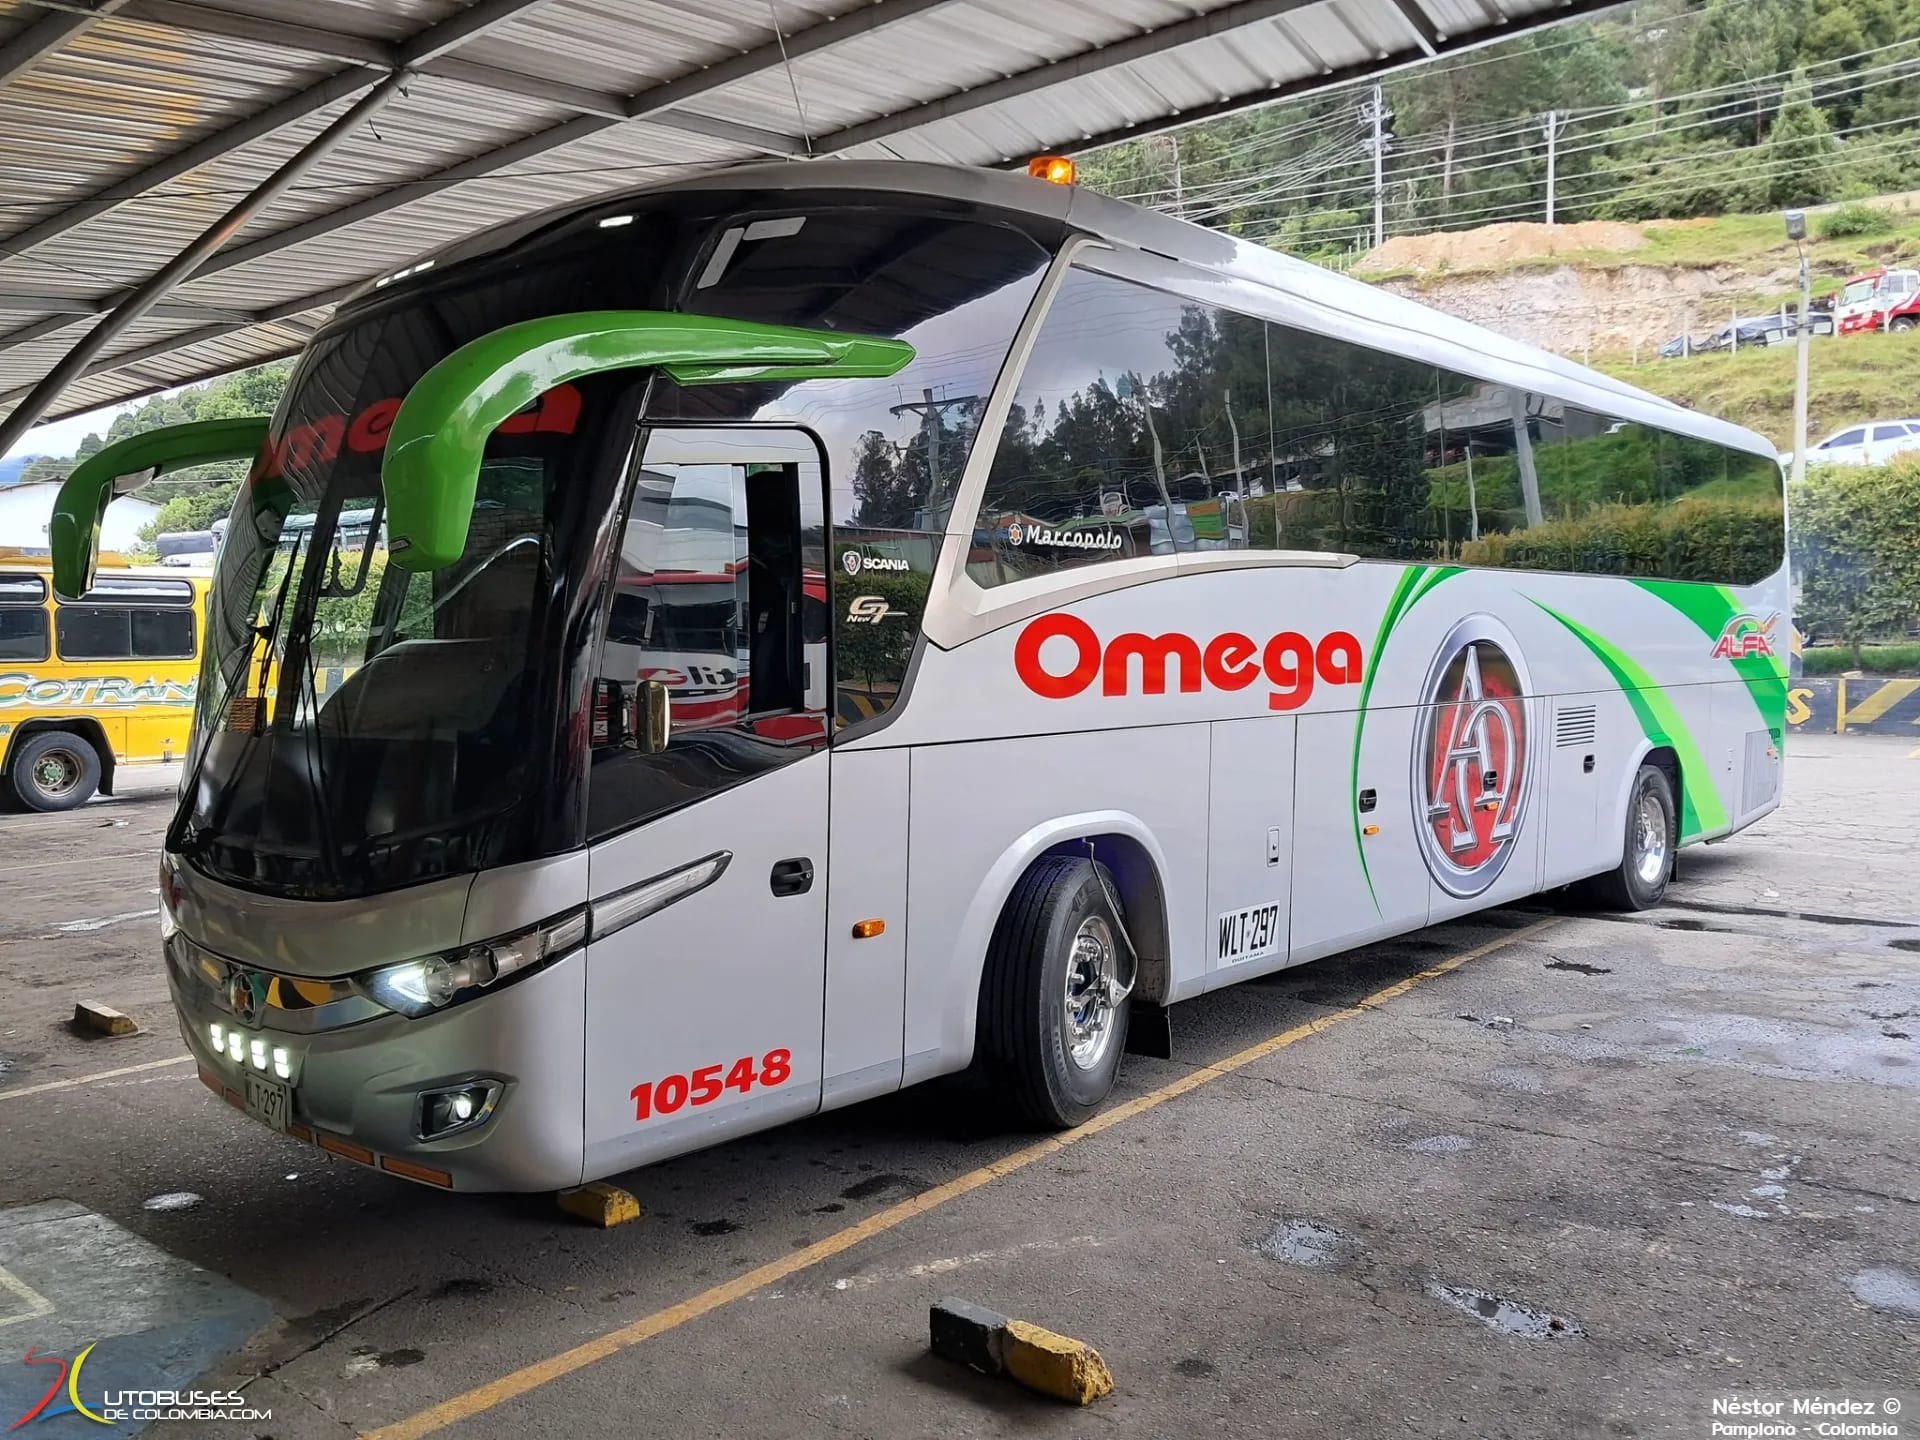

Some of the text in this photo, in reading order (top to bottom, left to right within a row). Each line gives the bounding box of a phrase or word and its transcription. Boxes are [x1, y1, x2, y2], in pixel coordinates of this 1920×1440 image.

[1026, 524, 1122, 550] Marcopolo
[863, 557, 910, 571] SCANIA
[1712, 634, 1774, 659] ALFA
[1014, 612, 1364, 711] Omega
[630, 1048, 792, 1121] 10548
